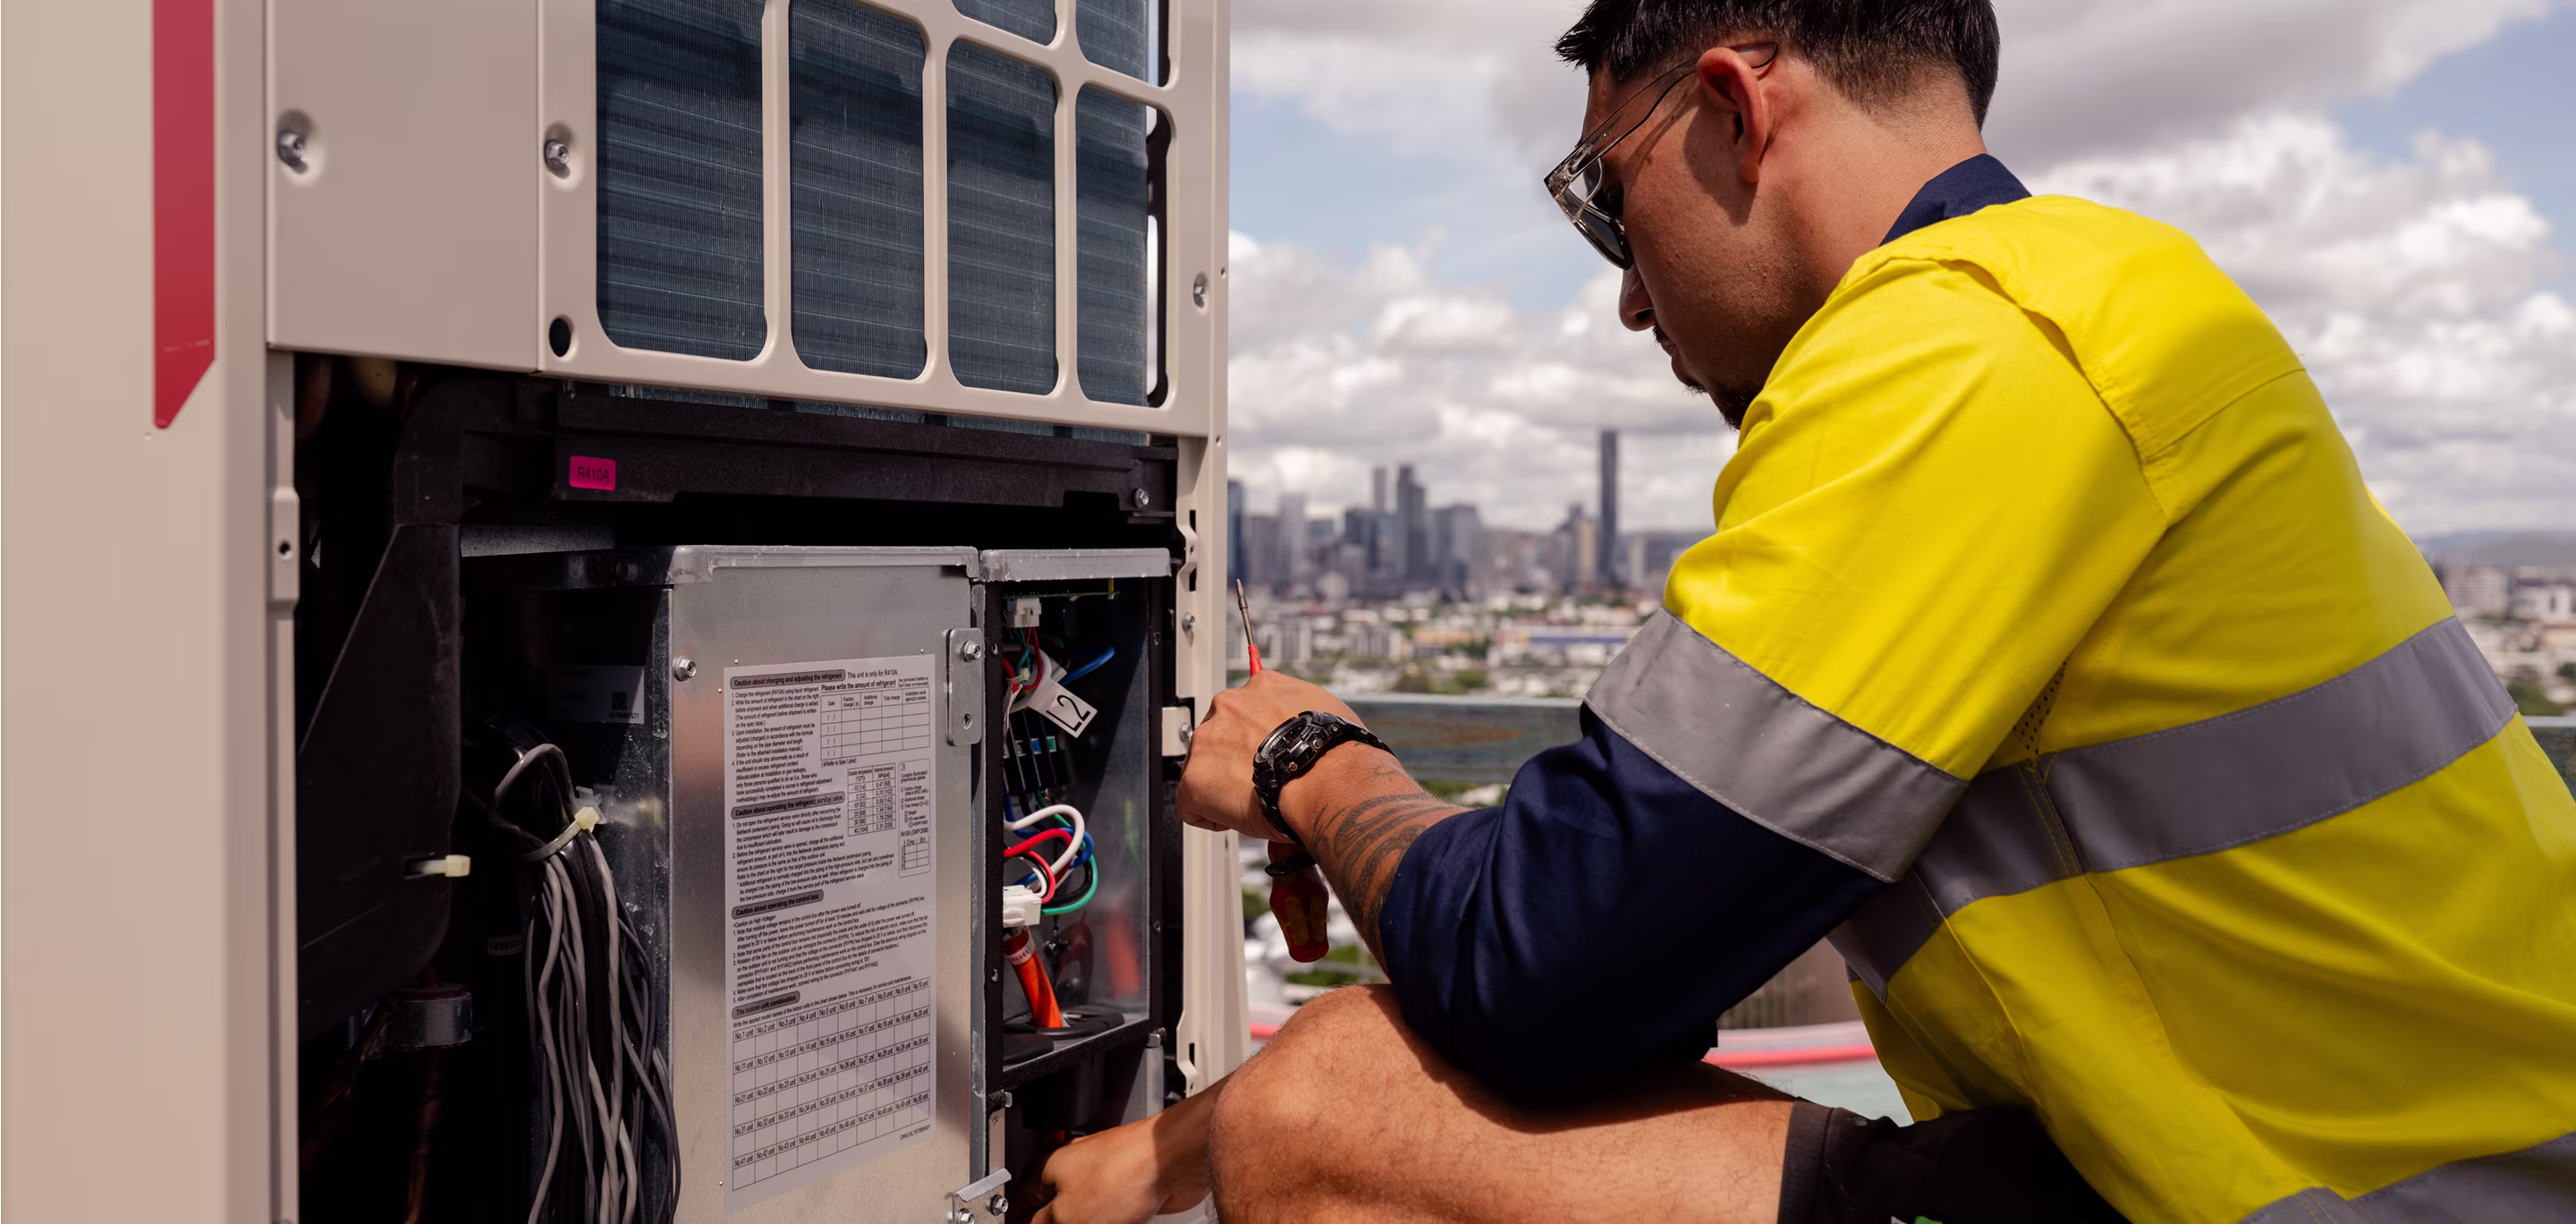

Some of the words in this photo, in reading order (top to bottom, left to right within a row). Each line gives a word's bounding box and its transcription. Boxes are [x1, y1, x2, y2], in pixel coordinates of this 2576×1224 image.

[577, 466, 610, 482] R410A
[734, 678, 751, 686] Caution
[766, 676, 784, 685] charging
[794, 675, 813, 684] adjusting
[821, 672, 843, 682] refrigerant
[869, 670, 877, 679] only
[876, 679, 896, 688] refrigerant
[1046, 694, 1091, 732] L2
[735, 808, 752, 817] Caution
[753, 805, 767, 814] about
[767, 803, 787, 813] operating
[795, 798, 817, 809] refrigerant
[817, 795, 832, 804] service
[735, 906, 753, 916] Caution
[754, 904, 767, 913] about
[767, 899, 787, 911] operating
[796, 895, 810, 904] control
[877, 990, 886, 1000] No.8
[896, 986, 904, 995] No.9
[736, 1007, 745, 1016] The
[745, 1003, 760, 1014] indoor
[760, 1000, 769, 1009] unit
[770, 993, 796, 1007] combination
[839, 1001, 849, 1011] No.6
[858, 996, 867, 1006] No.7
[819, 1007, 829, 1016] No.5
[778, 1018, 789, 1028] No.3
[799, 1013, 809, 1023] No.4
[757, 1024, 767, 1034] No.2
[767, 1022, 775, 1032] unit
[735, 1031, 745, 1041] No.1
[745, 1028, 754, 1038] unit
[735, 1062, 746, 1072] No.11
[746, 1059, 754, 1069] unit
[757, 1056, 768, 1066] No.12
[735, 1093, 746, 1104] No.21
[734, 1125, 746, 1136] No.31
[746, 1122, 754, 1132] unit
[735, 1157, 746, 1168] No.41
[746, 1154, 754, 1163] unit
